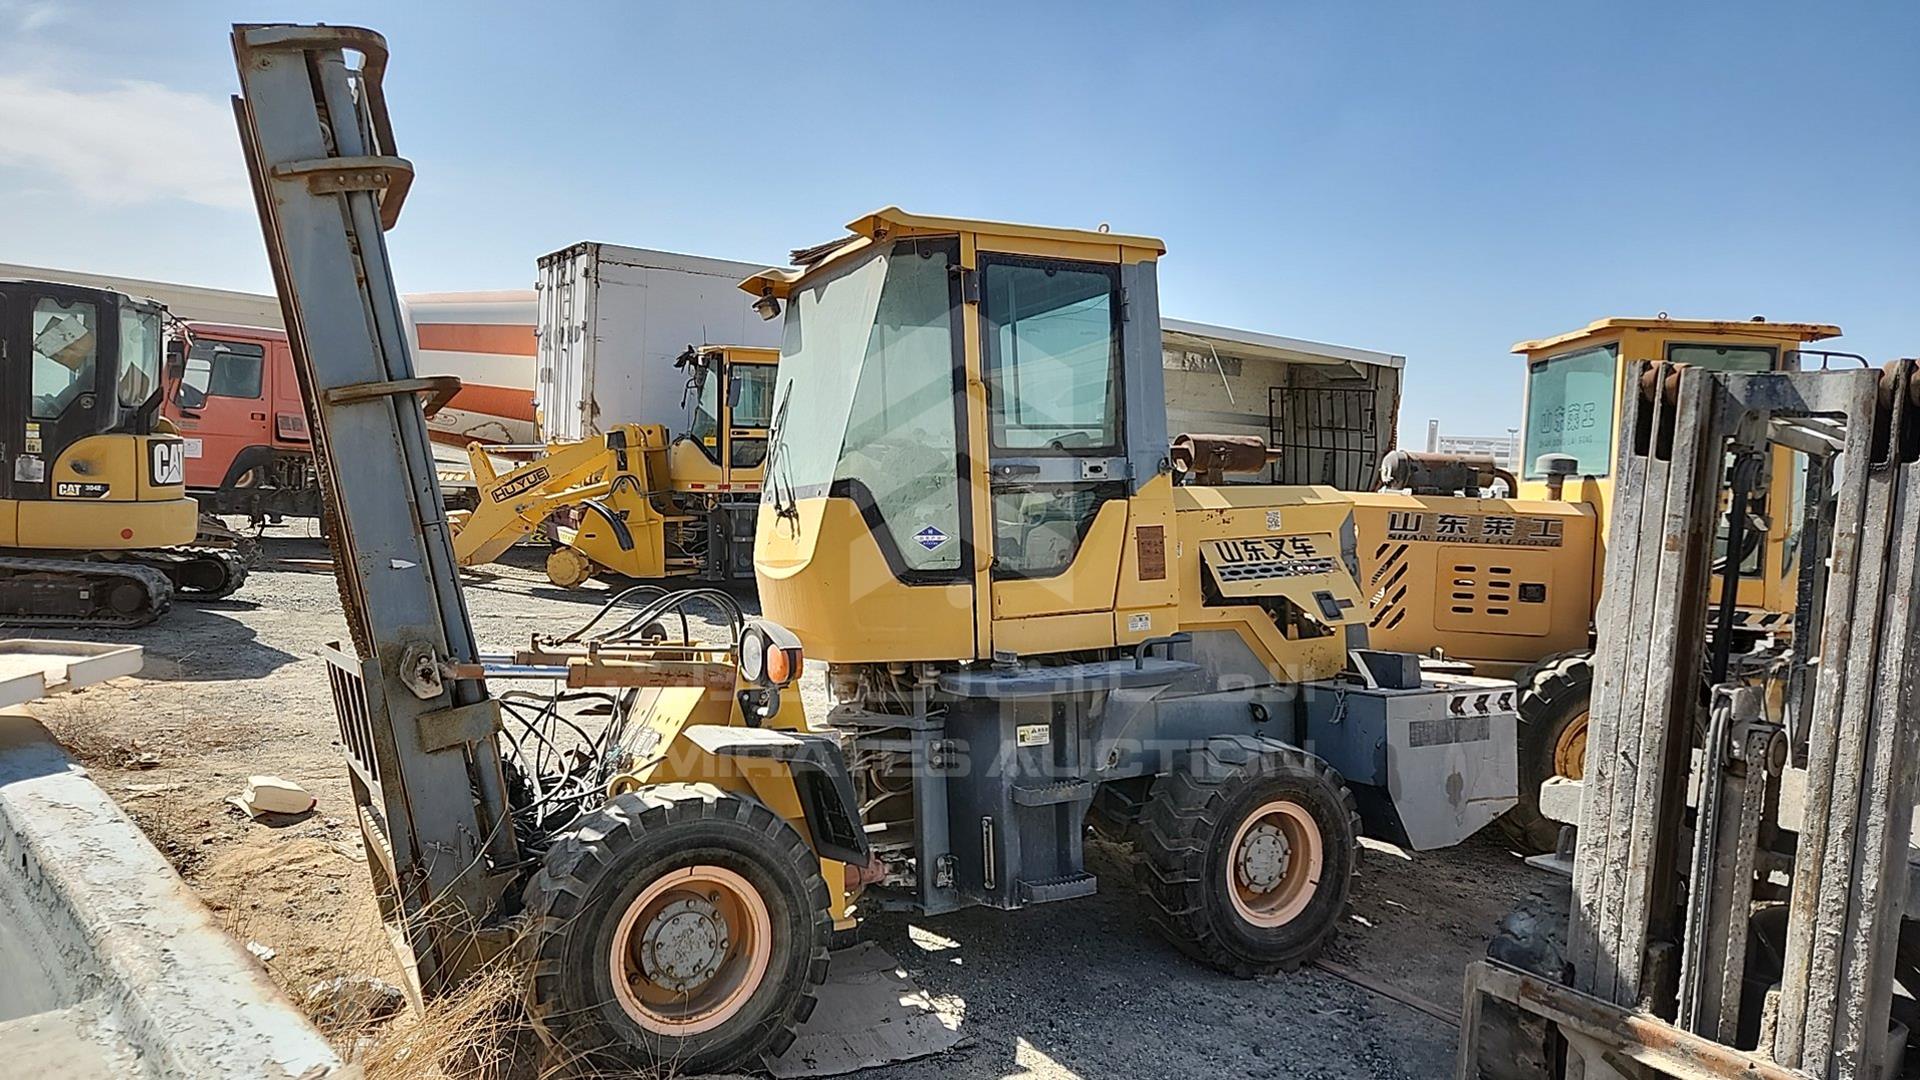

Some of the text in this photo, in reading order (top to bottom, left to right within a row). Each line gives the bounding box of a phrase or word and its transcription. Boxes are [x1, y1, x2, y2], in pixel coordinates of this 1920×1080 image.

[58, 484, 82, 496] CAT
[494, 469, 548, 500] HUYUE
[1388, 511, 1564, 538] 山东莱工
[1388, 533, 1430, 542] SHAN
[1214, 536, 1317, 563] 山东叉车
